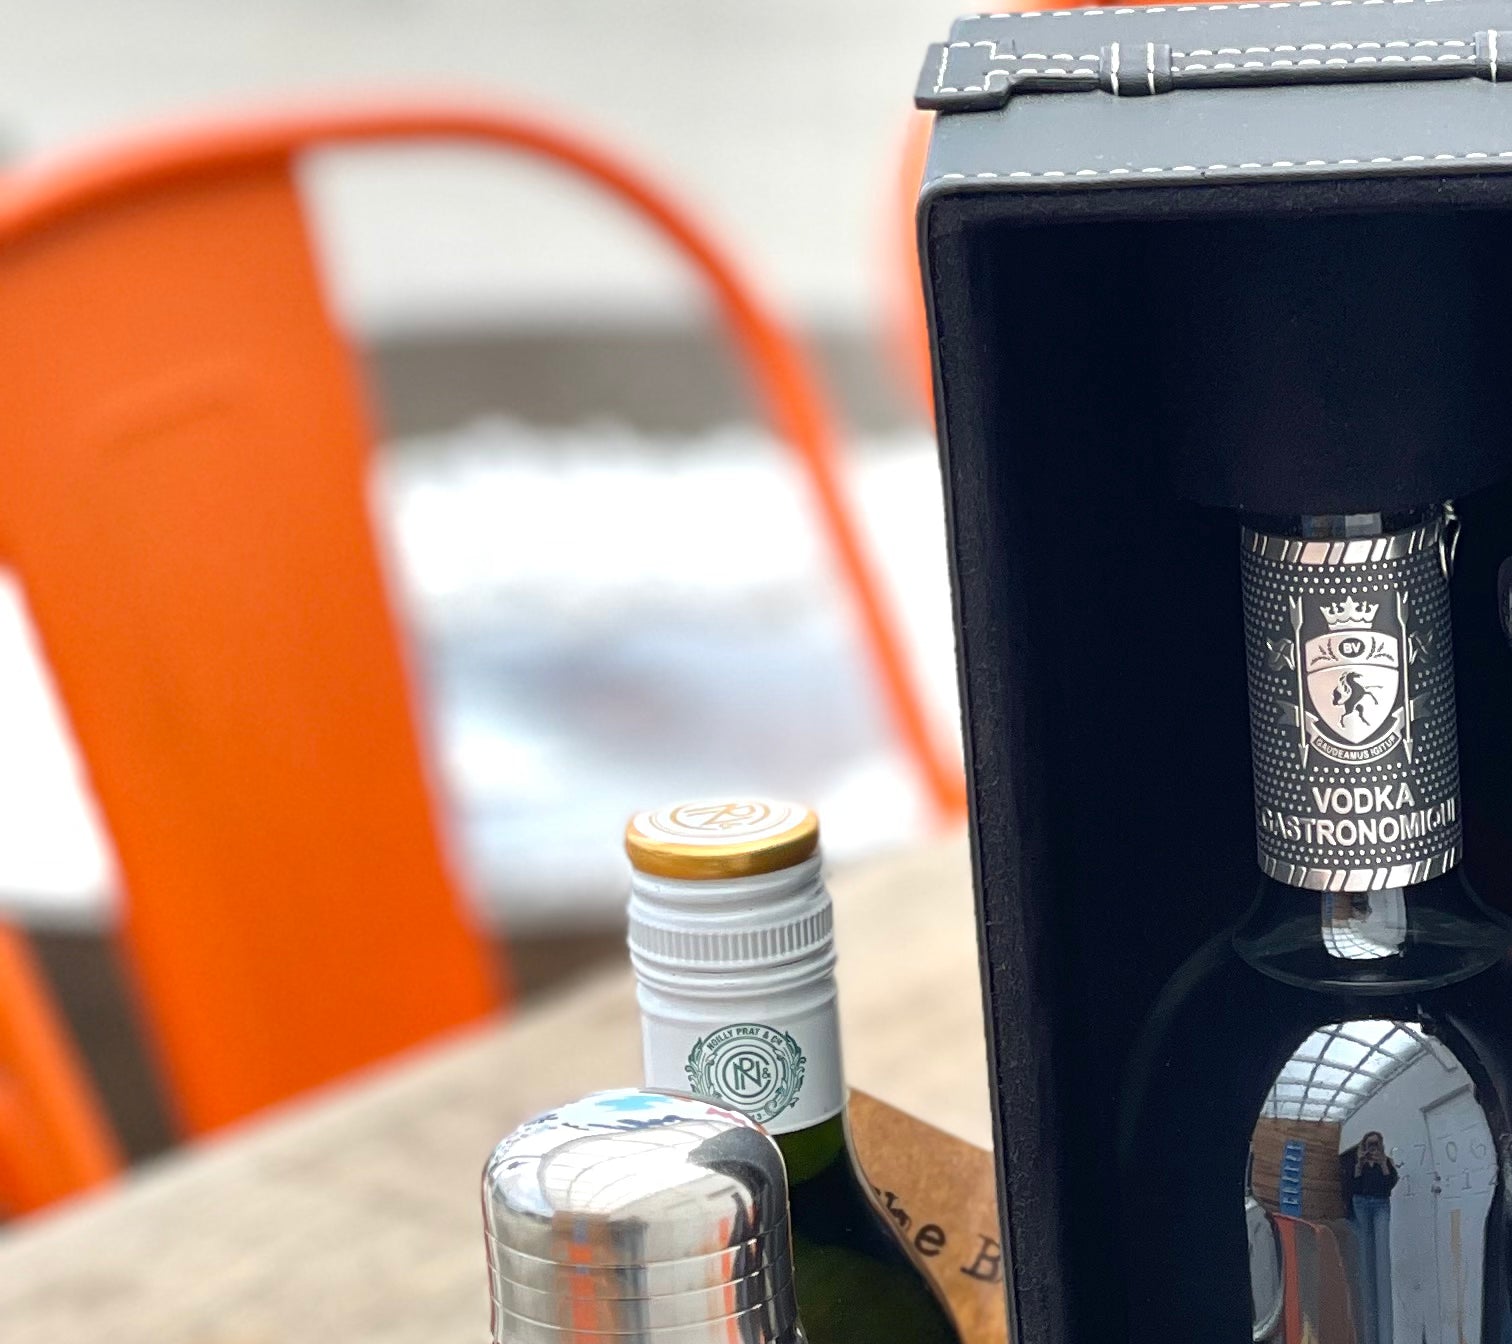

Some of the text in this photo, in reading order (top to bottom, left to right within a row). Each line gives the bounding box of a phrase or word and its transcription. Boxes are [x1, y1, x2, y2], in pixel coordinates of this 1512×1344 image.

[1342, 641, 1361, 655] BV
[1312, 782, 1416, 815] VODKA
[706, 1029, 734, 1051] NOILLY
[736, 1027, 761, 1036] PRAT
